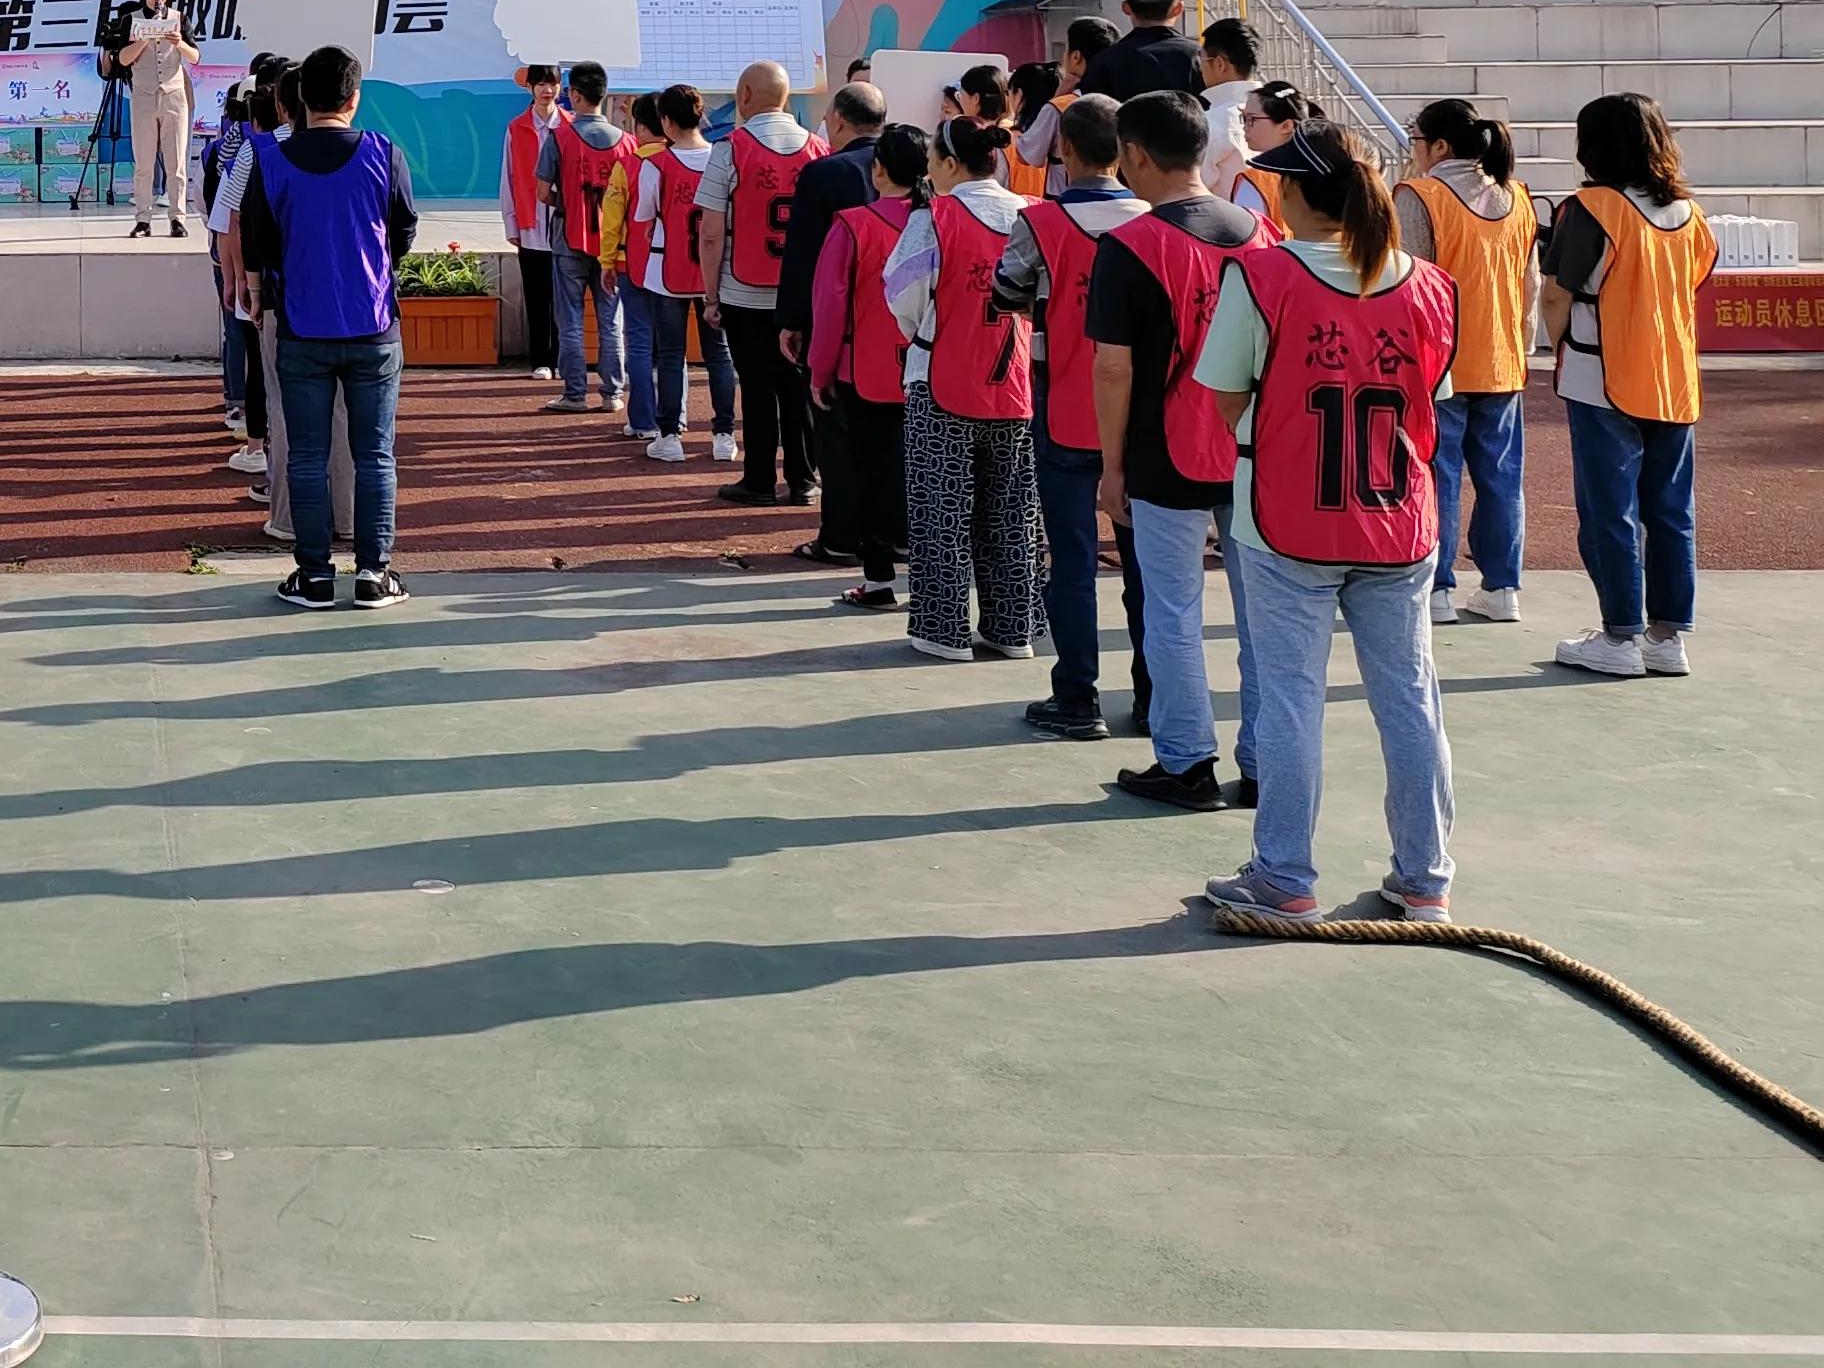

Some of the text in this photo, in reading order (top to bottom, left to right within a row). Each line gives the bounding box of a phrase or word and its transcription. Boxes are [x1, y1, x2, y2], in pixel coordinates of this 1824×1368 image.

[8, 78, 72, 101] 第一名
[1304, 319, 1418, 376] 芯谷
[1304, 381, 1412, 513] 10
